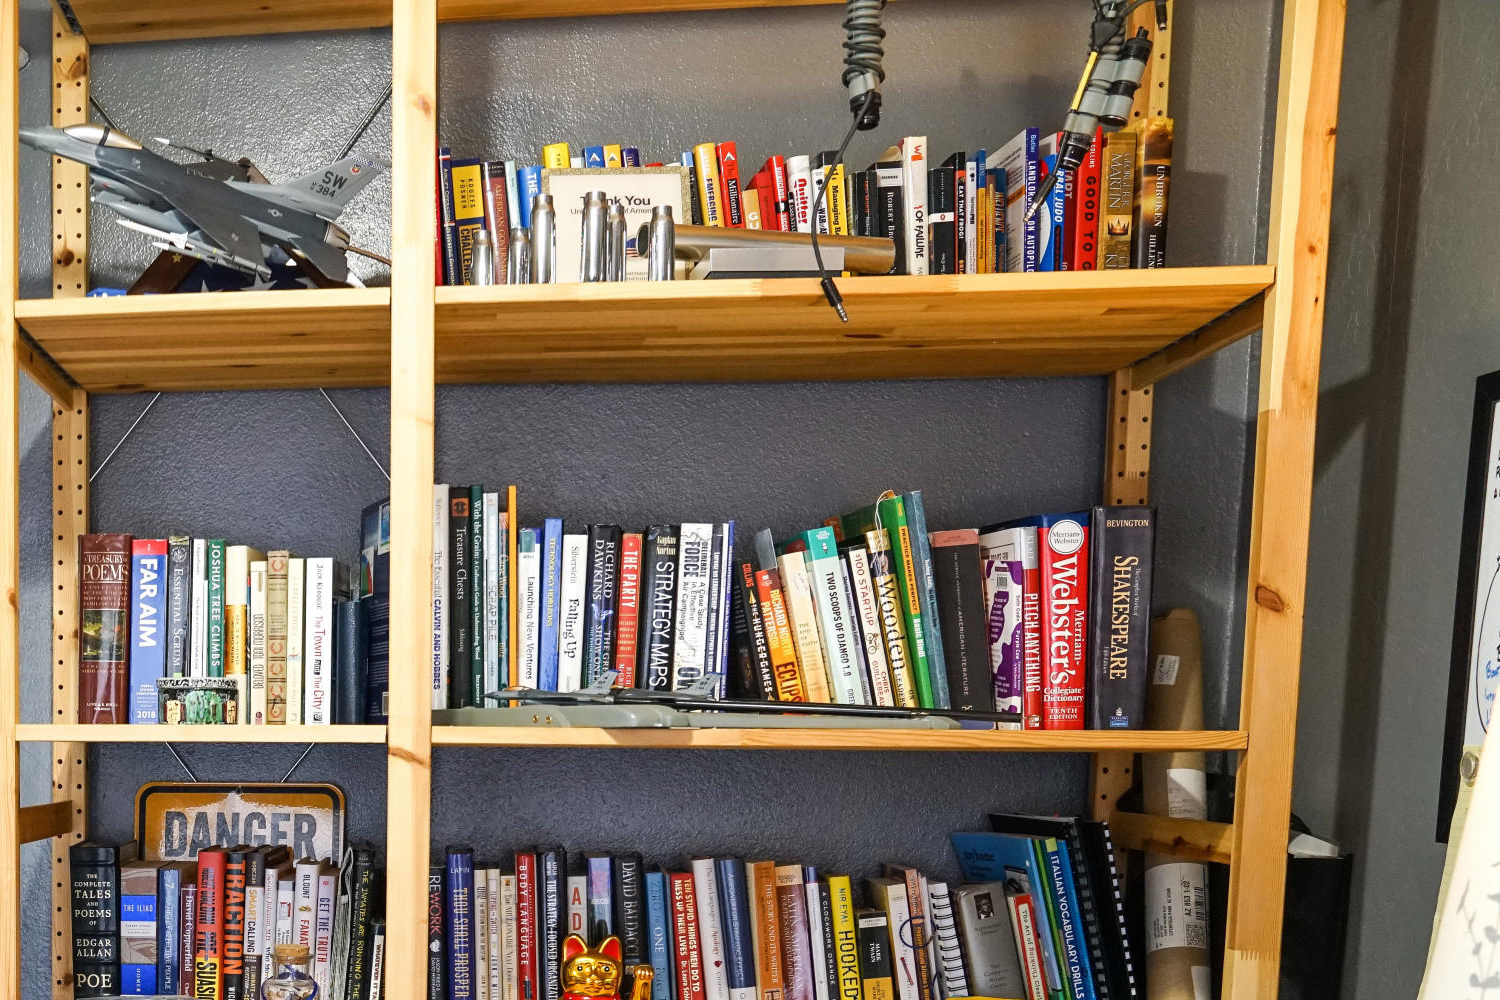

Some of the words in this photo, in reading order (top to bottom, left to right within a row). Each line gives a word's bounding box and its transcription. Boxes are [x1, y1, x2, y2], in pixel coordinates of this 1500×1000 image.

[316, 185, 336, 199] 384
[322, 169, 348, 190] SW
[1109, 153, 1122, 209] MARTIN
[1085, 176, 1096, 221] GOOD
[1153, 165, 1165, 227] UNBROKEN
[1084, 230, 1093, 253] TO
[1106, 519, 1150, 528] BEVINGTON
[456, 526, 467, 566] Treasure
[683, 541, 701, 577] FORCE
[83, 566, 128, 582] POEMS
[211, 544, 221, 590] JOSHUA
[593, 540, 604, 601] DAWKINS
[604, 542, 615, 598] RICHARD
[624, 551, 639, 574] THE
[742, 563, 754, 588] COLLINS
[140, 558, 158, 603] FAR
[173, 568, 184, 623] ESSENTIAL
[456, 568, 468, 601] Chests
[622, 576, 637, 608] PARTY
[211, 596, 221, 619] TREE
[526, 576, 536, 619] Launching
[652, 562, 675, 640] STRATEGY
[858, 578, 874, 626] STARTUP
[1024, 593, 1038, 630] PITCH
[139, 605, 157, 648] AIM
[526, 621, 535, 641] New
[565, 598, 580, 641] Falling
[878, 576, 906, 671] Wooden
[1049, 554, 1080, 686] Webster's
[1109, 556, 1139, 680] SHAKESPEARE
[173, 628, 184, 667] SCRUM
[210, 625, 221, 667] CLIMBS
[525, 643, 537, 680] Ventures
[564, 643, 577, 659] Up
[649, 646, 670, 688] MAPS
[1025, 633, 1041, 693] ANYTHING
[1043, 687, 1083, 697] Collegiate
[1043, 695, 1085, 704] Dictionary
[136, 710, 156, 719] 2018
[1049, 713, 1079, 721] EDITION
[164, 809, 317, 864] DANGER
[302, 873, 311, 900] BLOUNT
[450, 867, 471, 875] LAPIN
[519, 865, 528, 896] BODY
[621, 862, 636, 897] DAVID
[684, 878, 692, 892] TEN
[1050, 856, 1067, 895] ITALIAN
[74, 890, 112, 899] TALES
[319, 897, 330, 912] GET
[428, 875, 443, 936] REWORK
[452, 888, 468, 914] THOU
[674, 879, 683, 900] MESS
[74, 909, 112, 918] POEMS
[223, 859, 246, 975] TRACTION
[676, 902, 683, 911] UP
[685, 894, 695, 920] STUPID
[318, 916, 329, 932] THE
[453, 917, 469, 951] SHALL
[520, 902, 529, 966] LANGUAGE
[623, 901, 638, 958] BALDACCI
[677, 912, 686, 934] THEIR
[687, 921, 697, 949] THINGS
[1058, 896, 1078, 964] VOCABULARY
[76, 939, 112, 948] EDGAR
[76, 948, 112, 957] ALLAN
[317, 935, 328, 963] TRUTH
[654, 927, 665, 953] ONE
[679, 935, 687, 956] LIVES
[823, 900, 832, 949] CLOCKWORK
[828, 952, 837, 986] ORANGE
[689, 950, 699, 966] MEN
[691, 967, 699, 980] DO
[76, 973, 113, 989] POE
[453, 954, 469, 998] PROSPER
[692, 981, 700, 993] TO
[1071, 966, 1085, 1000] DRILLS
